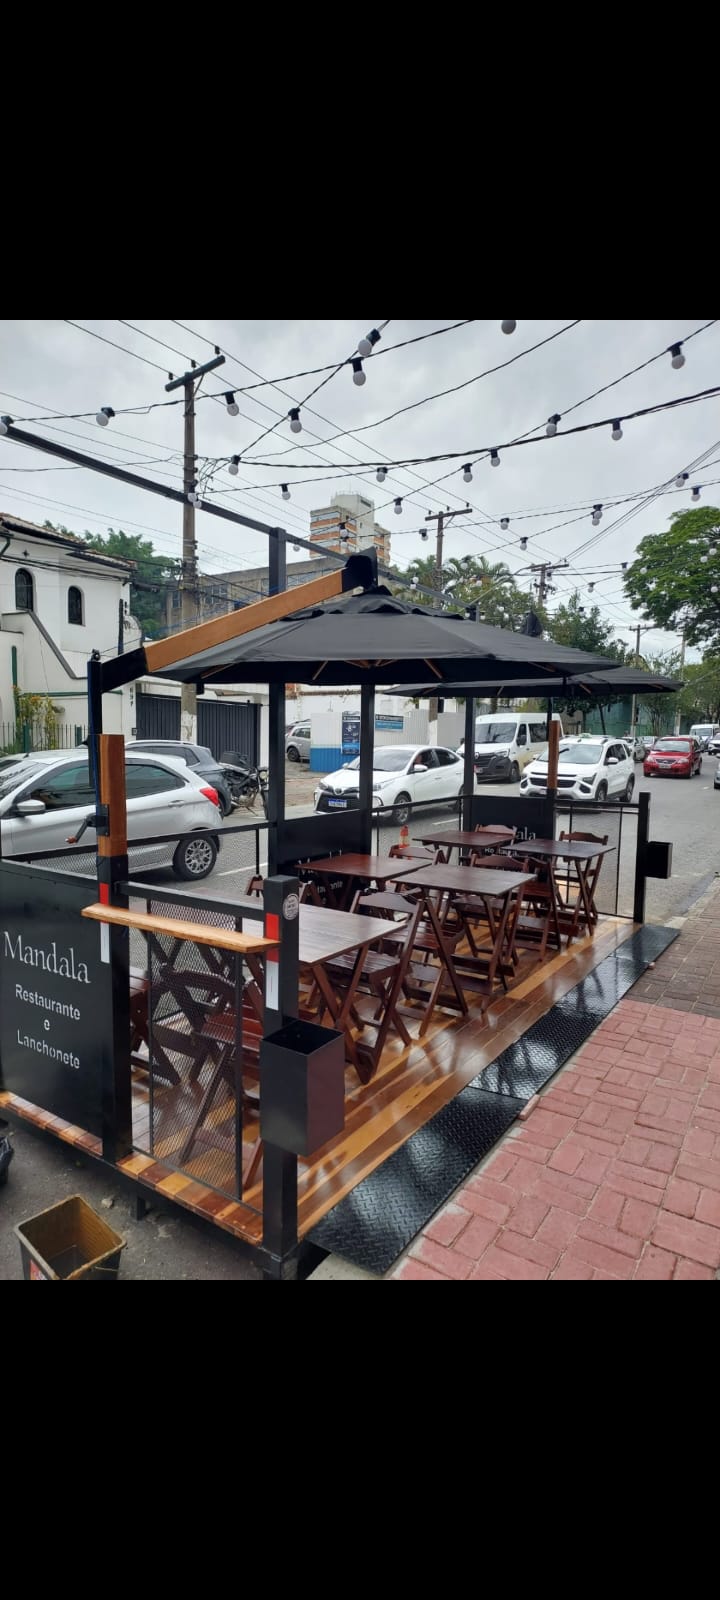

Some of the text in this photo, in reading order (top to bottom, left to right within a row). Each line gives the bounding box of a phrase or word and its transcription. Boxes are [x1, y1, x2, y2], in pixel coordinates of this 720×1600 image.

[4, 931, 91, 983] Mandala
[15, 984, 80, 1020] Restaurante
[43, 1019, 51, 1030] e
[17, 1029, 80, 1069] Lanchonete
